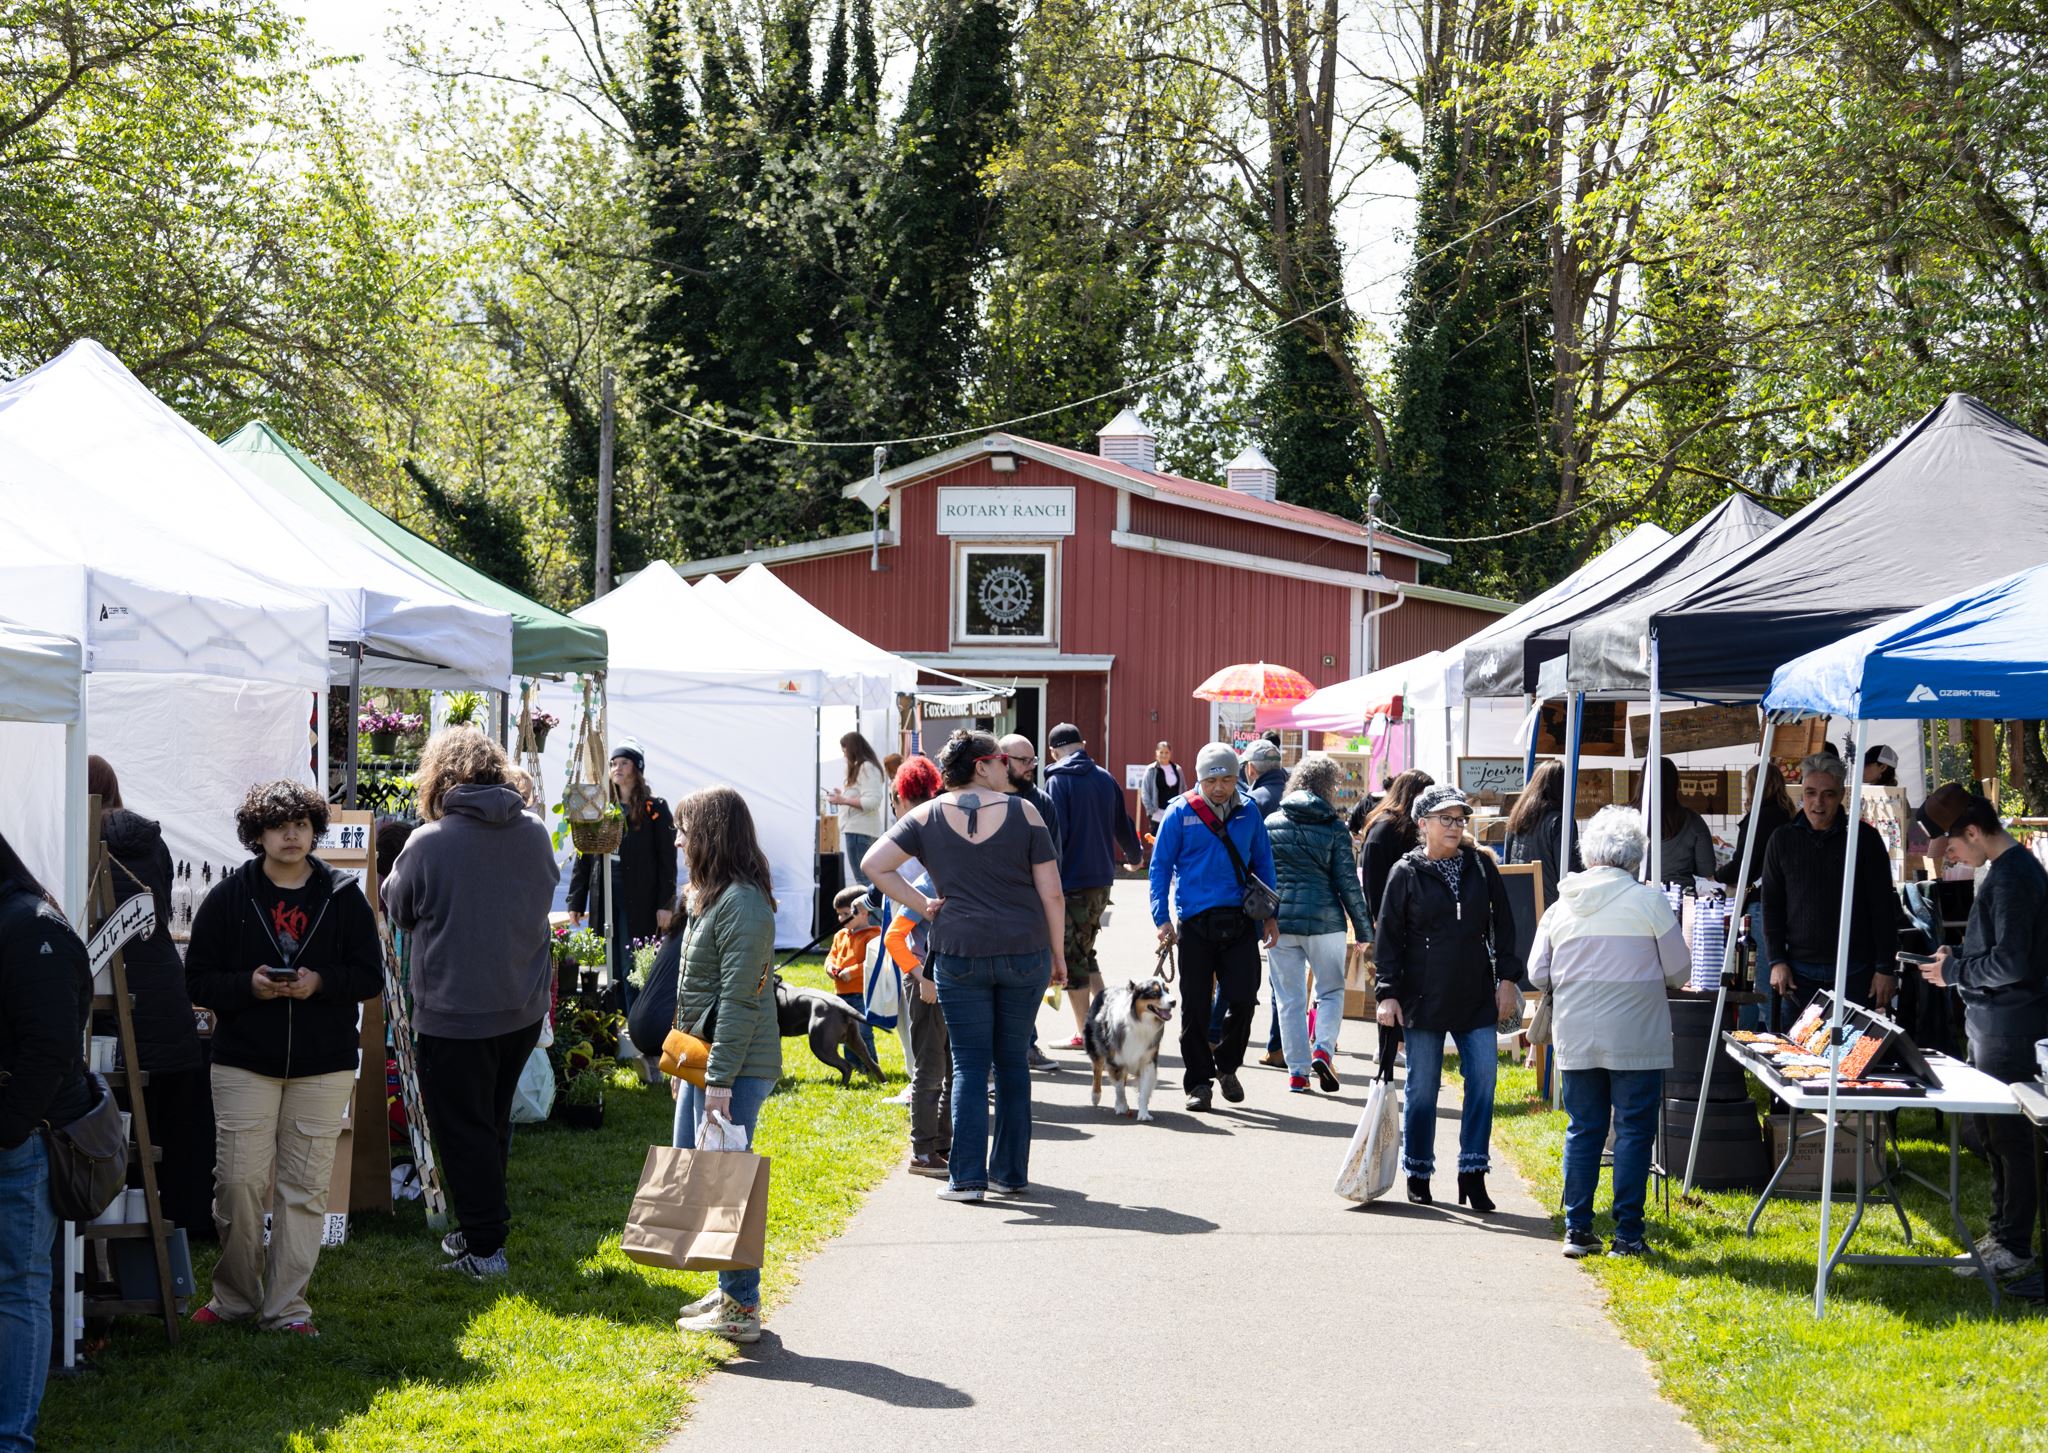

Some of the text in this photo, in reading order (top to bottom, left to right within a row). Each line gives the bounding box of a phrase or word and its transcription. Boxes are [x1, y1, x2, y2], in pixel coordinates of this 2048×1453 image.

[946, 504, 1066, 517] ROTARY RANCH
[972, 699, 1002, 717] Design
[1233, 731, 1260, 741] FLOWER
[1473, 762, 1524, 791] journ
